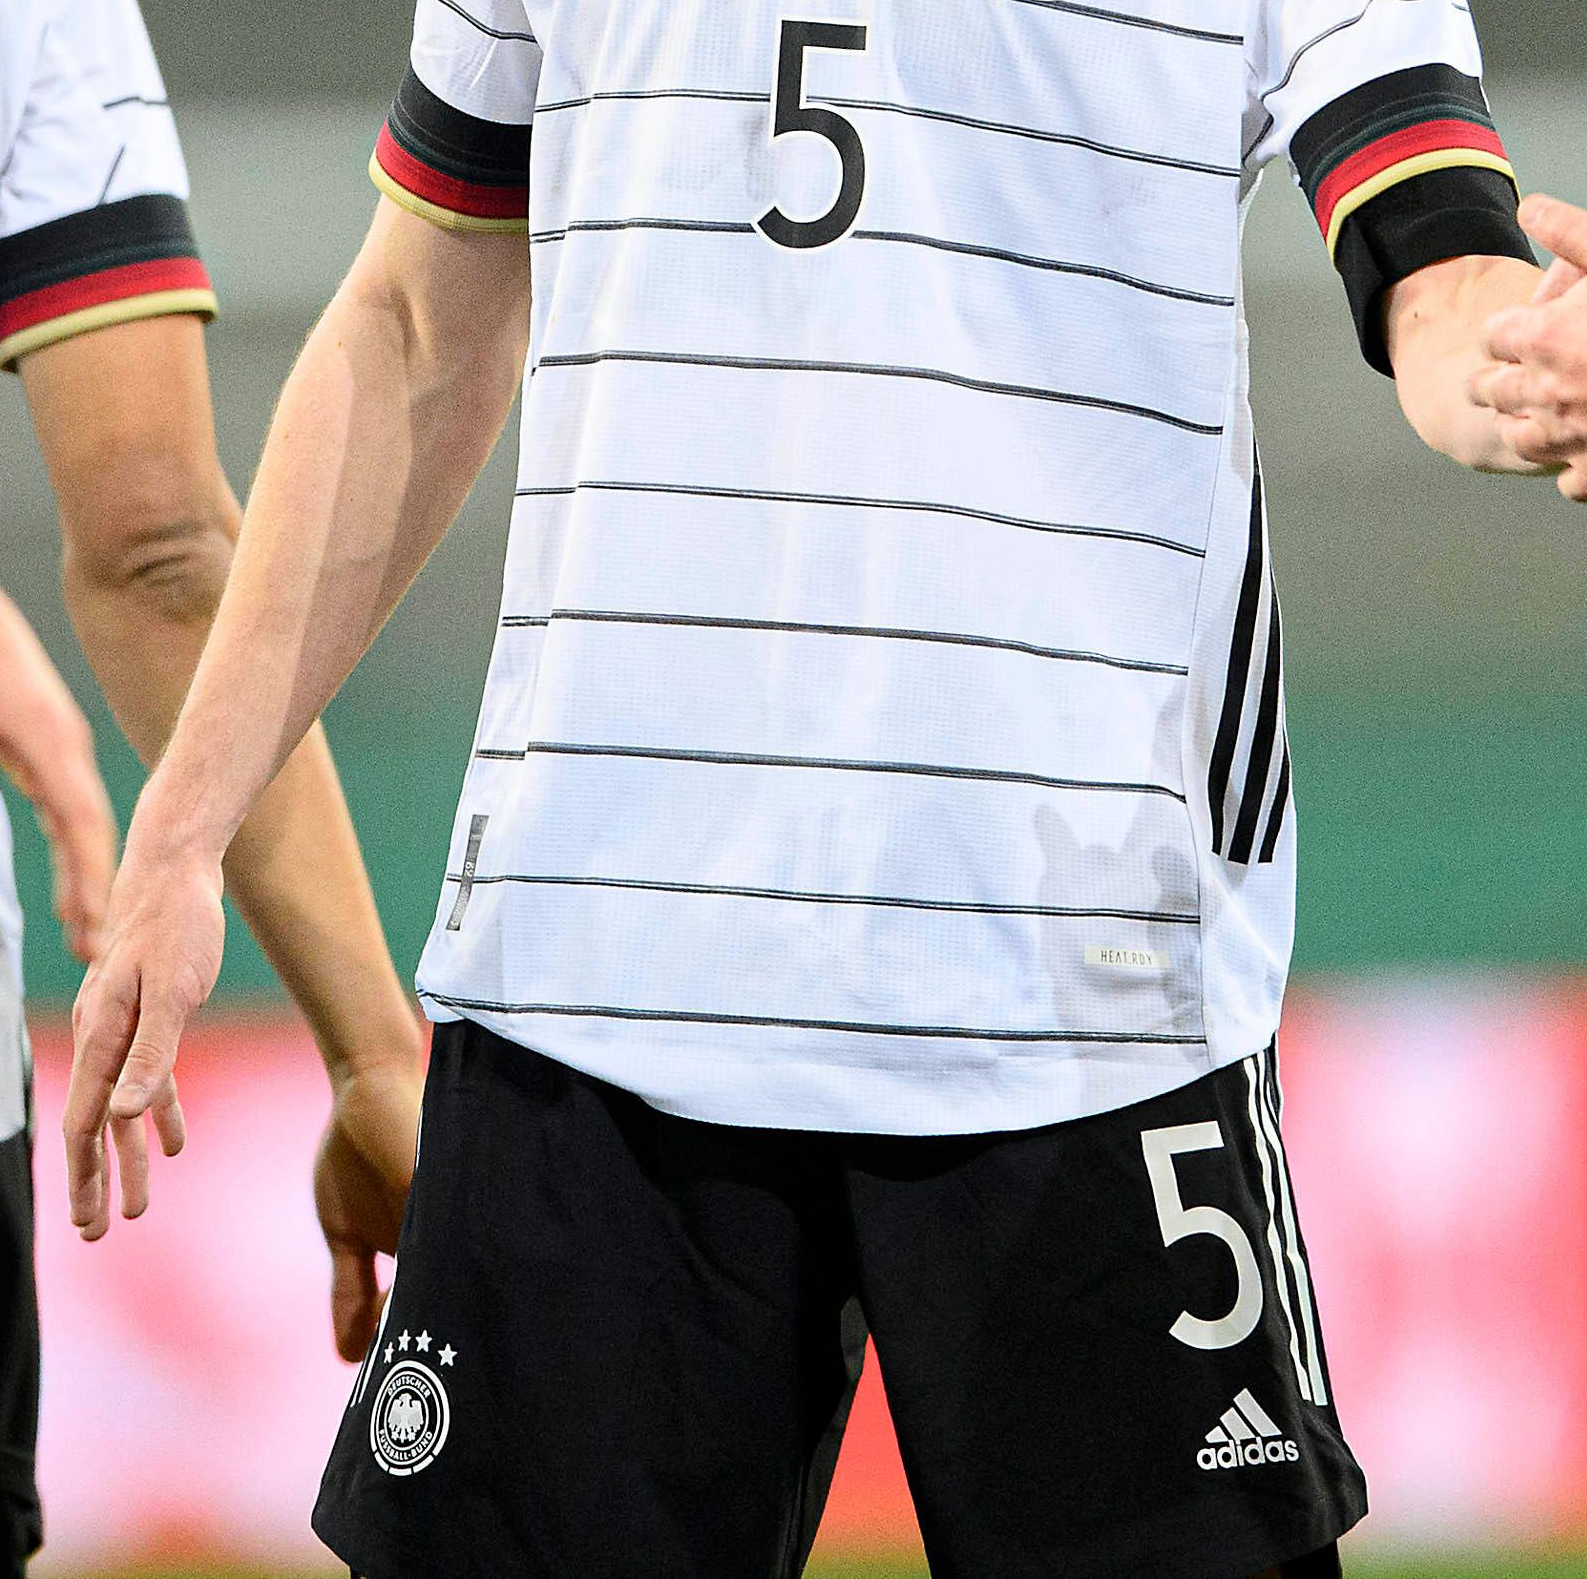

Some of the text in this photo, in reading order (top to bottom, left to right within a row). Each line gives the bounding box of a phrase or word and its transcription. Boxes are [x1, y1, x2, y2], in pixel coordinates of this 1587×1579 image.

[757, 19, 867, 249] 5
[1140, 1120, 1264, 1350] 5
[387, 1375, 431, 1399] DEUTSCHER
[1197, 1436, 1299, 1471] adidas
